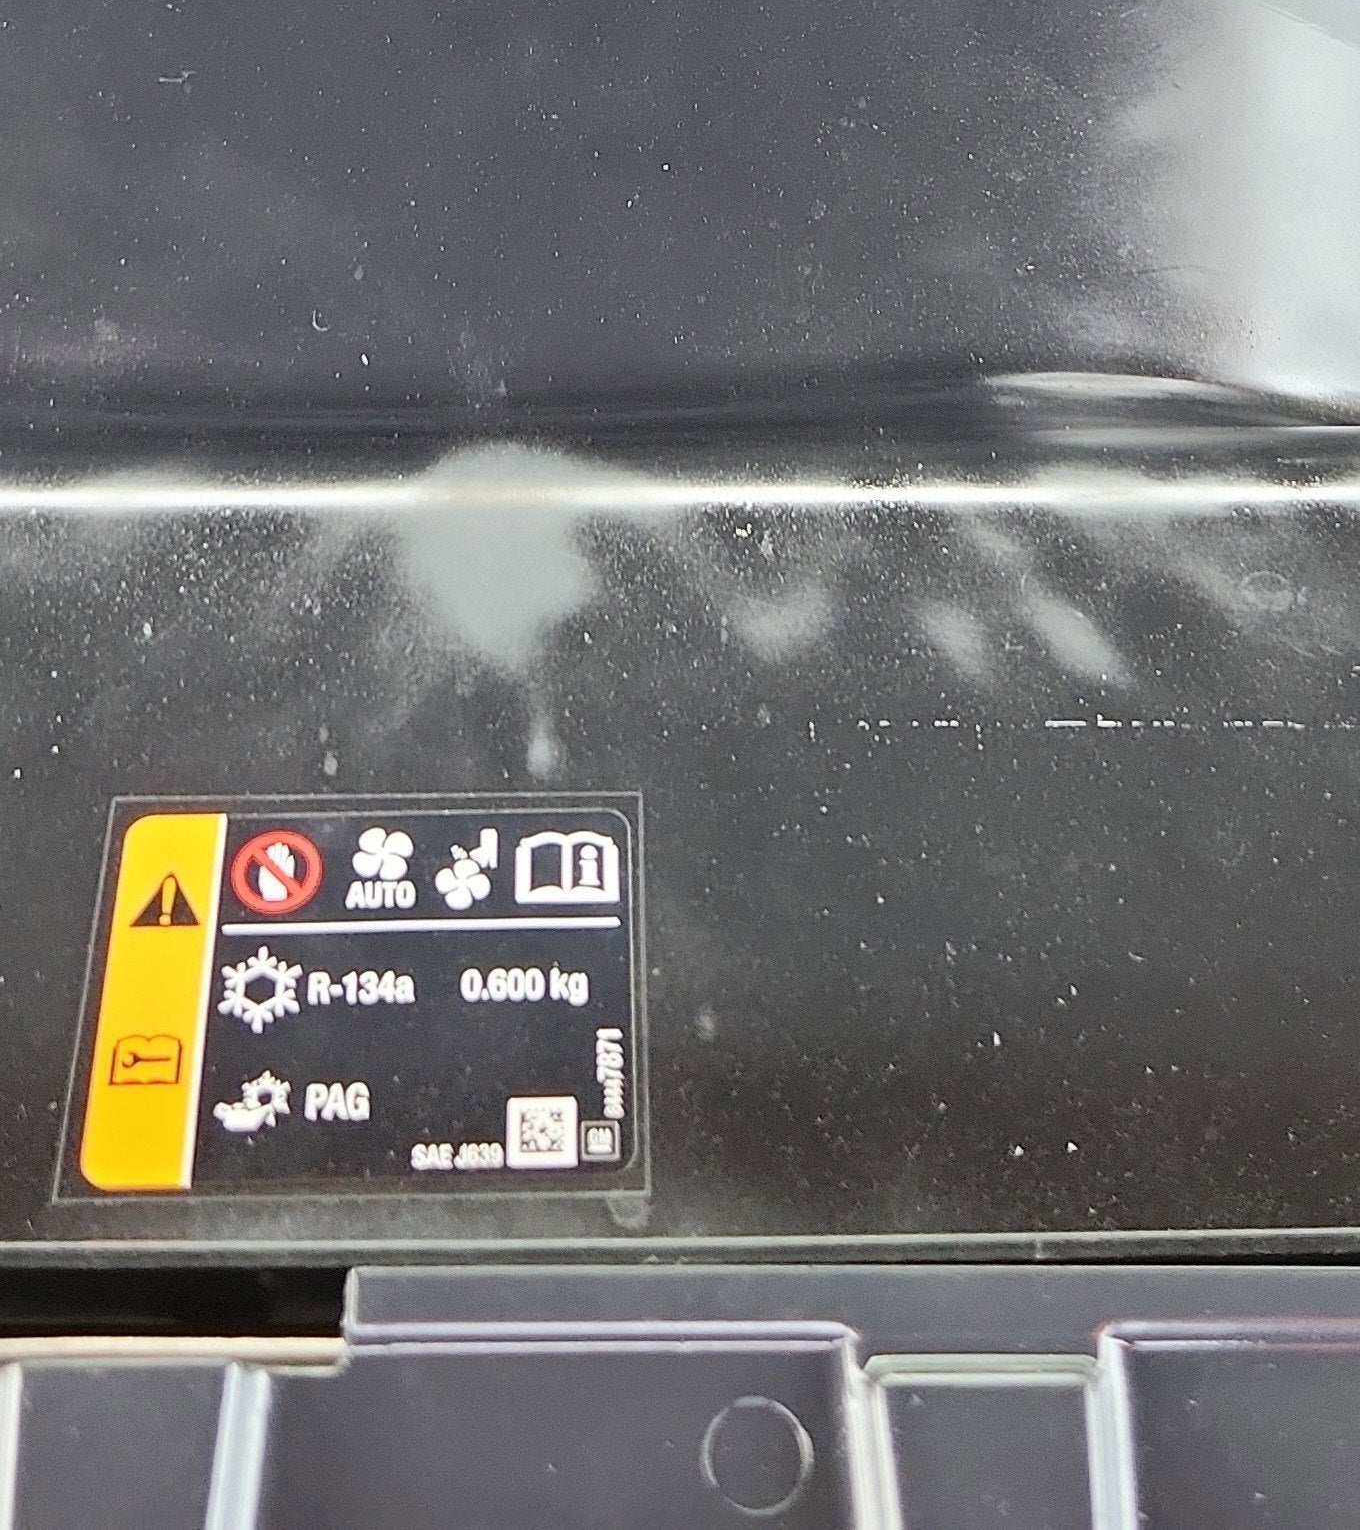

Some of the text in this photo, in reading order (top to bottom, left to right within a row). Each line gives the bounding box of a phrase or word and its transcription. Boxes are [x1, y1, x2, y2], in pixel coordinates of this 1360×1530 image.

[345, 880, 416, 910] AUTO
[307, 968, 590, 1006] R-134a 0.600 kg
[304, 1083, 371, 1122] PAG
[411, 1142, 504, 1171] SAE J639
